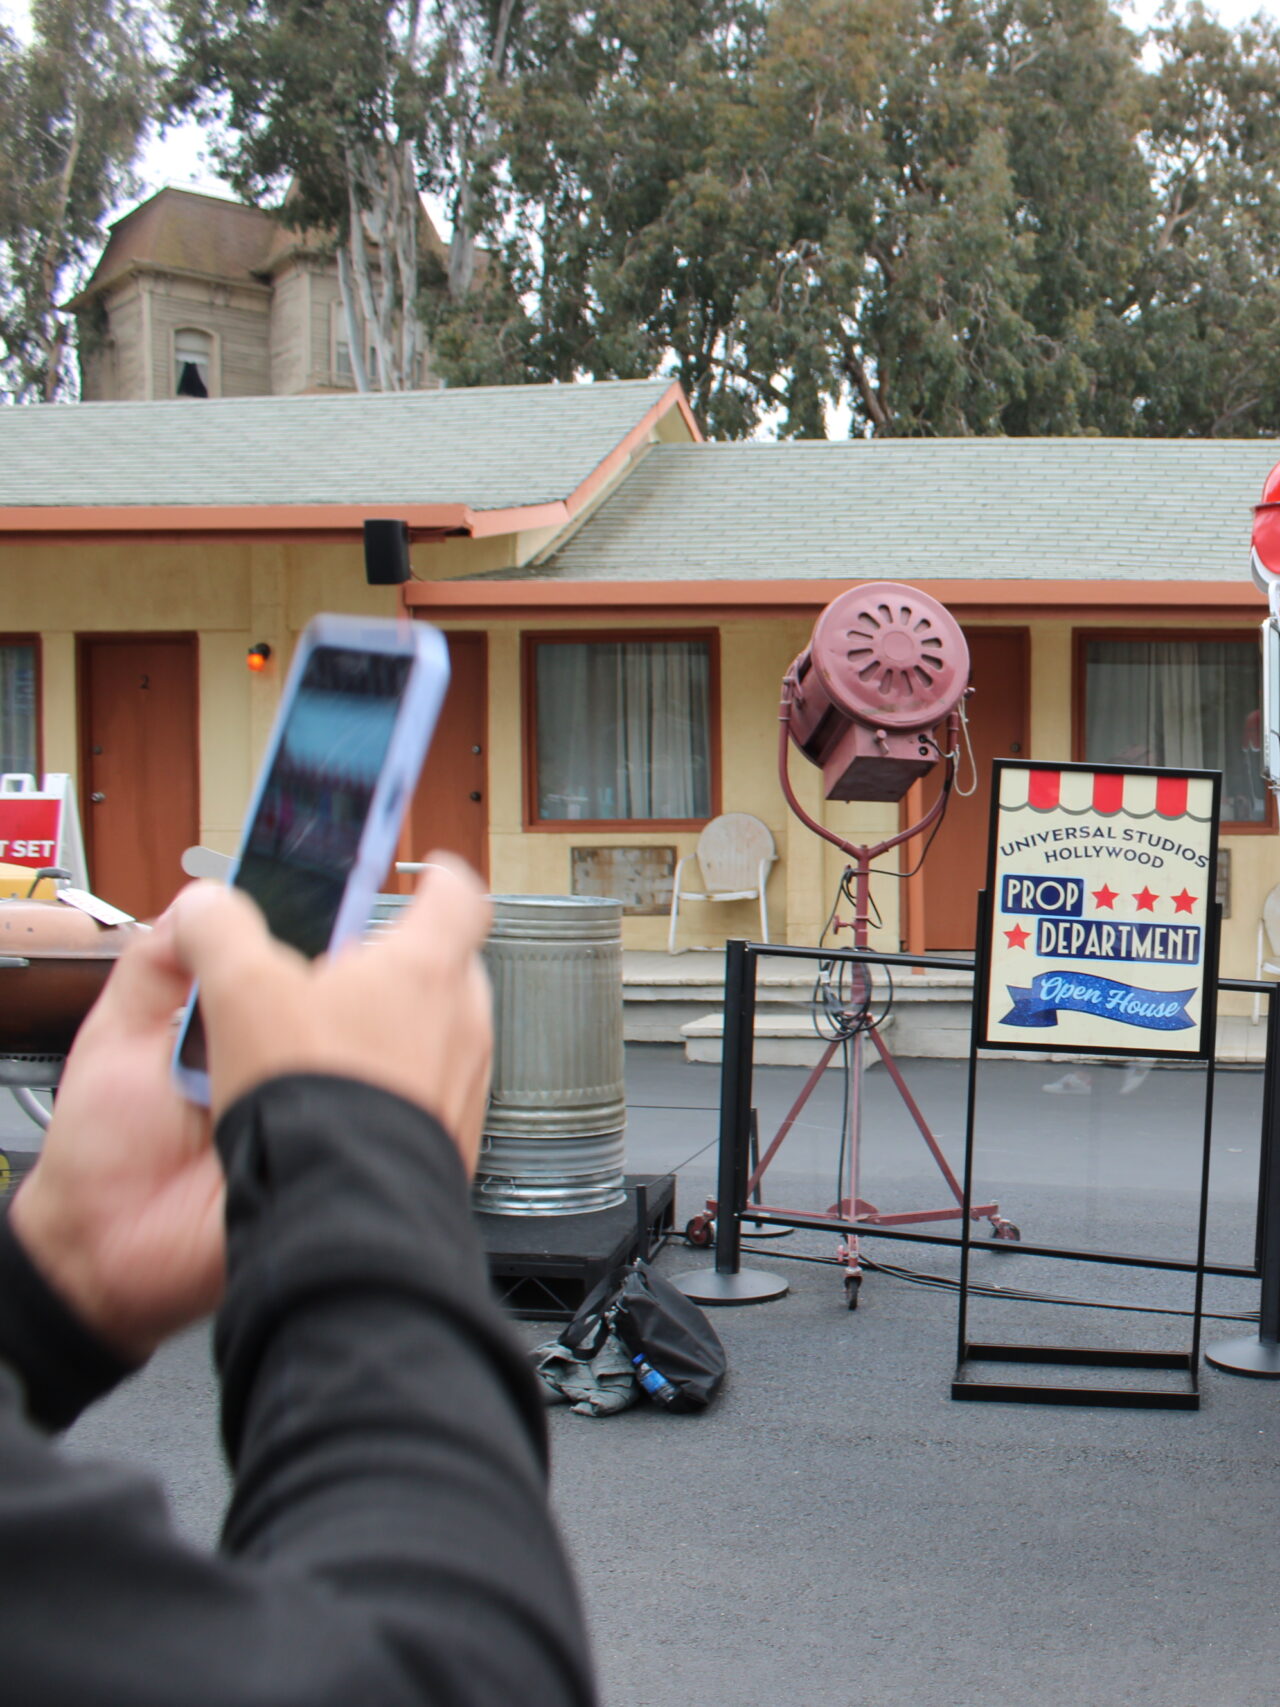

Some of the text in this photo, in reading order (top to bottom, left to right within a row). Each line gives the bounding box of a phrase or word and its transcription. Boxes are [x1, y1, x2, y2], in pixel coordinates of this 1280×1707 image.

[138, 674, 150, 689] 2
[12, 839, 55, 858] SET
[1000, 825, 1210, 869] UNIVERSAL STUDIOS
[1044, 845, 1165, 869] HOLLYWOOD
[1006, 878, 1080, 911] PROP
[1040, 921, 1199, 962] DEPARTMENT
[1040, 976, 1181, 1018] Open House
